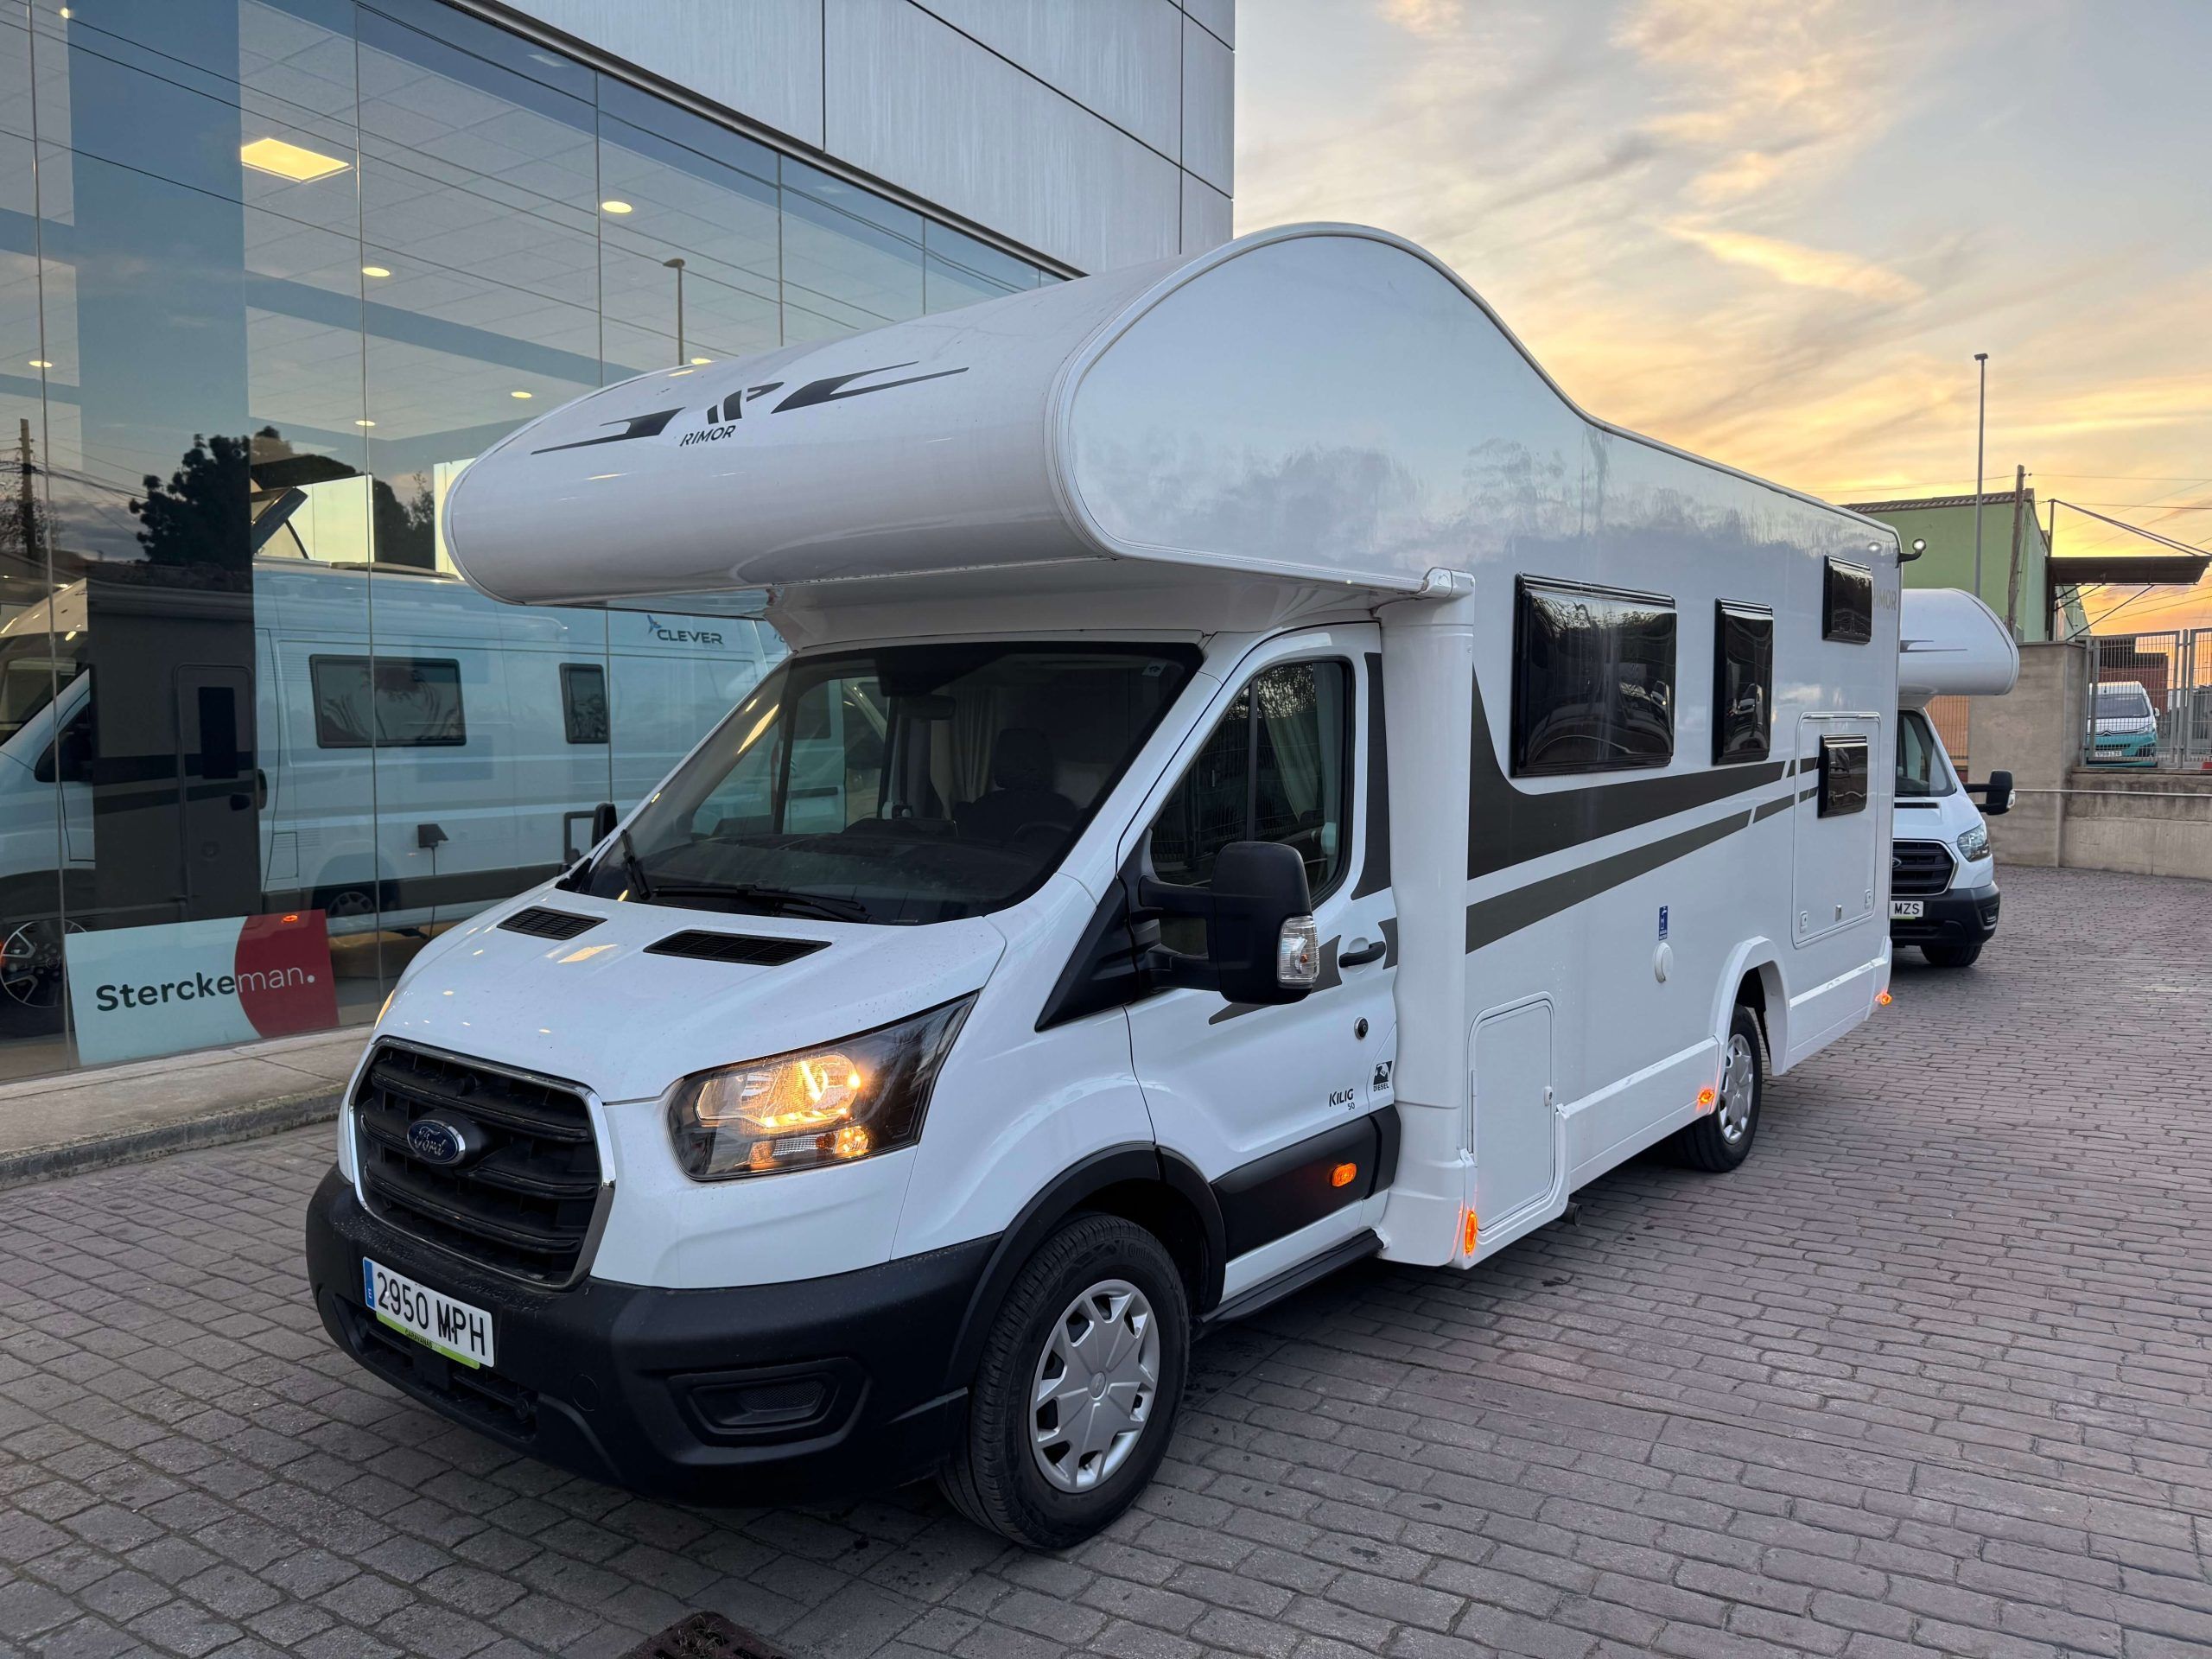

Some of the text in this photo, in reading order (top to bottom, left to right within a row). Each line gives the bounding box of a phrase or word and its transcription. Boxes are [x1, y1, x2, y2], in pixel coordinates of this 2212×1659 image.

[679, 424, 736, 447] RIMOR
[657, 628, 723, 645] CLEVER
[1894, 902, 1920, 915] MZS
[96, 966, 315, 1011] Sterckeman.
[1373, 1084, 1389, 1092] DIESEL
[414, 1126, 447, 1156] Ford
[377, 1271, 486, 1357] 2950 MPH
